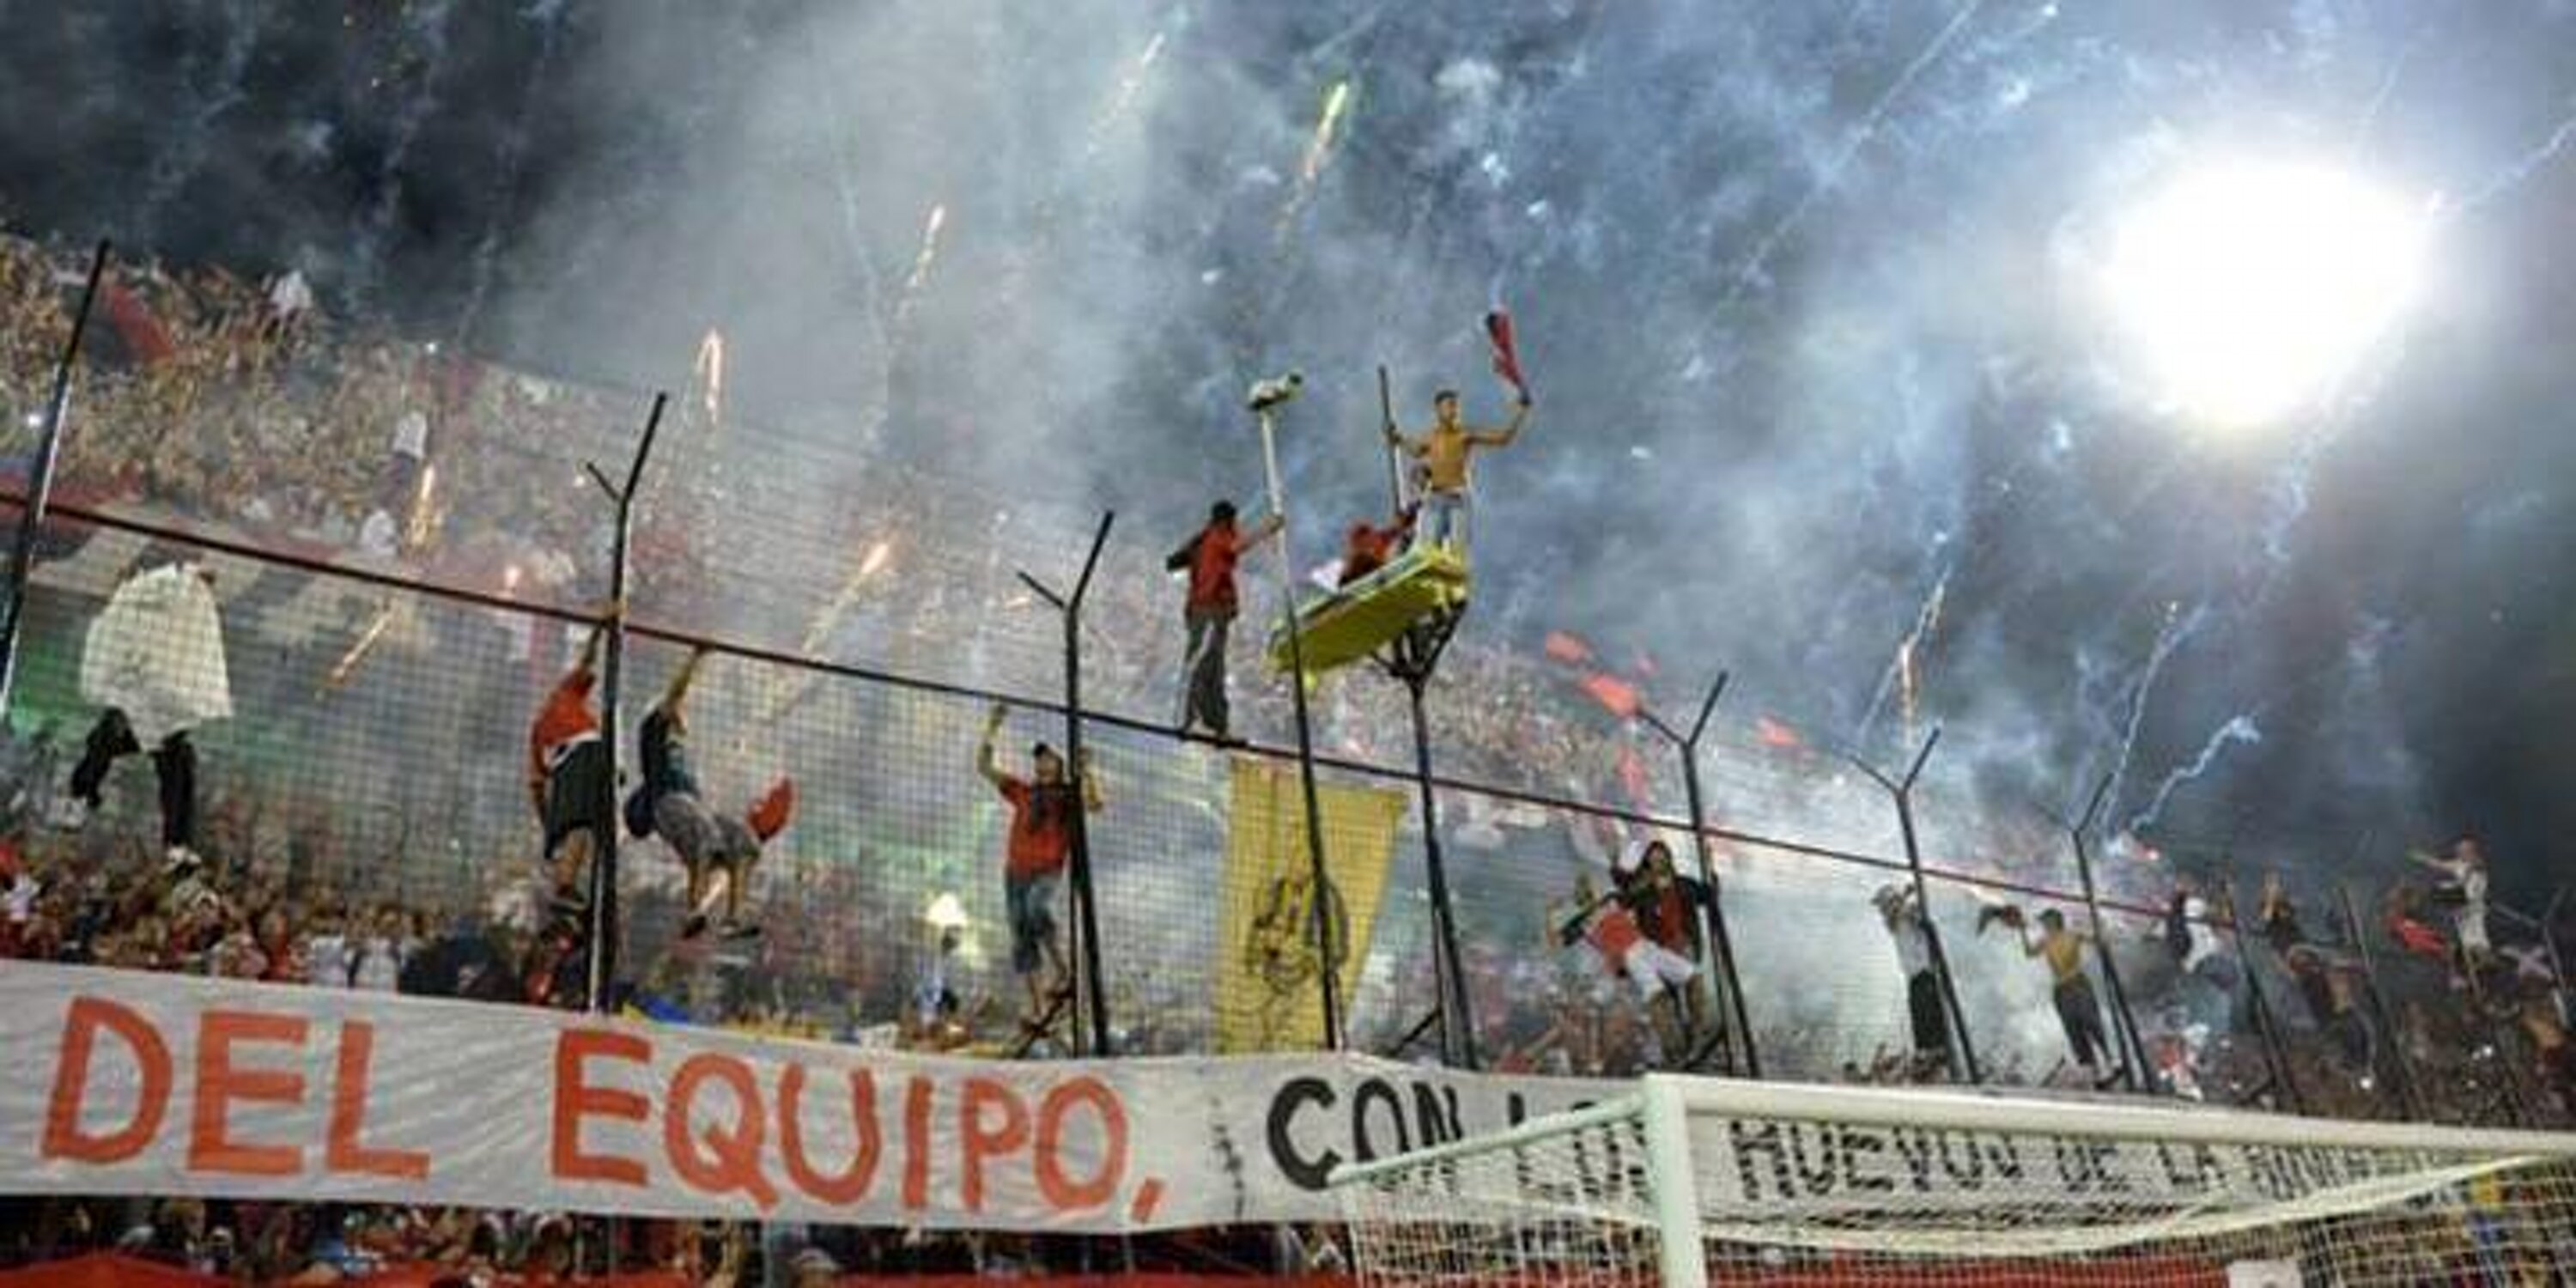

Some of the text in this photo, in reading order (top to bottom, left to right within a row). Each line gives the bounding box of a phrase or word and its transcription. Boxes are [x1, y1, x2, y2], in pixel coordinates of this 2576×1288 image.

[41, 994, 430, 1180] DEL
[551, 1027, 1165, 1224] EQUIPO,
[1267, 1076, 1463, 1192] CON
